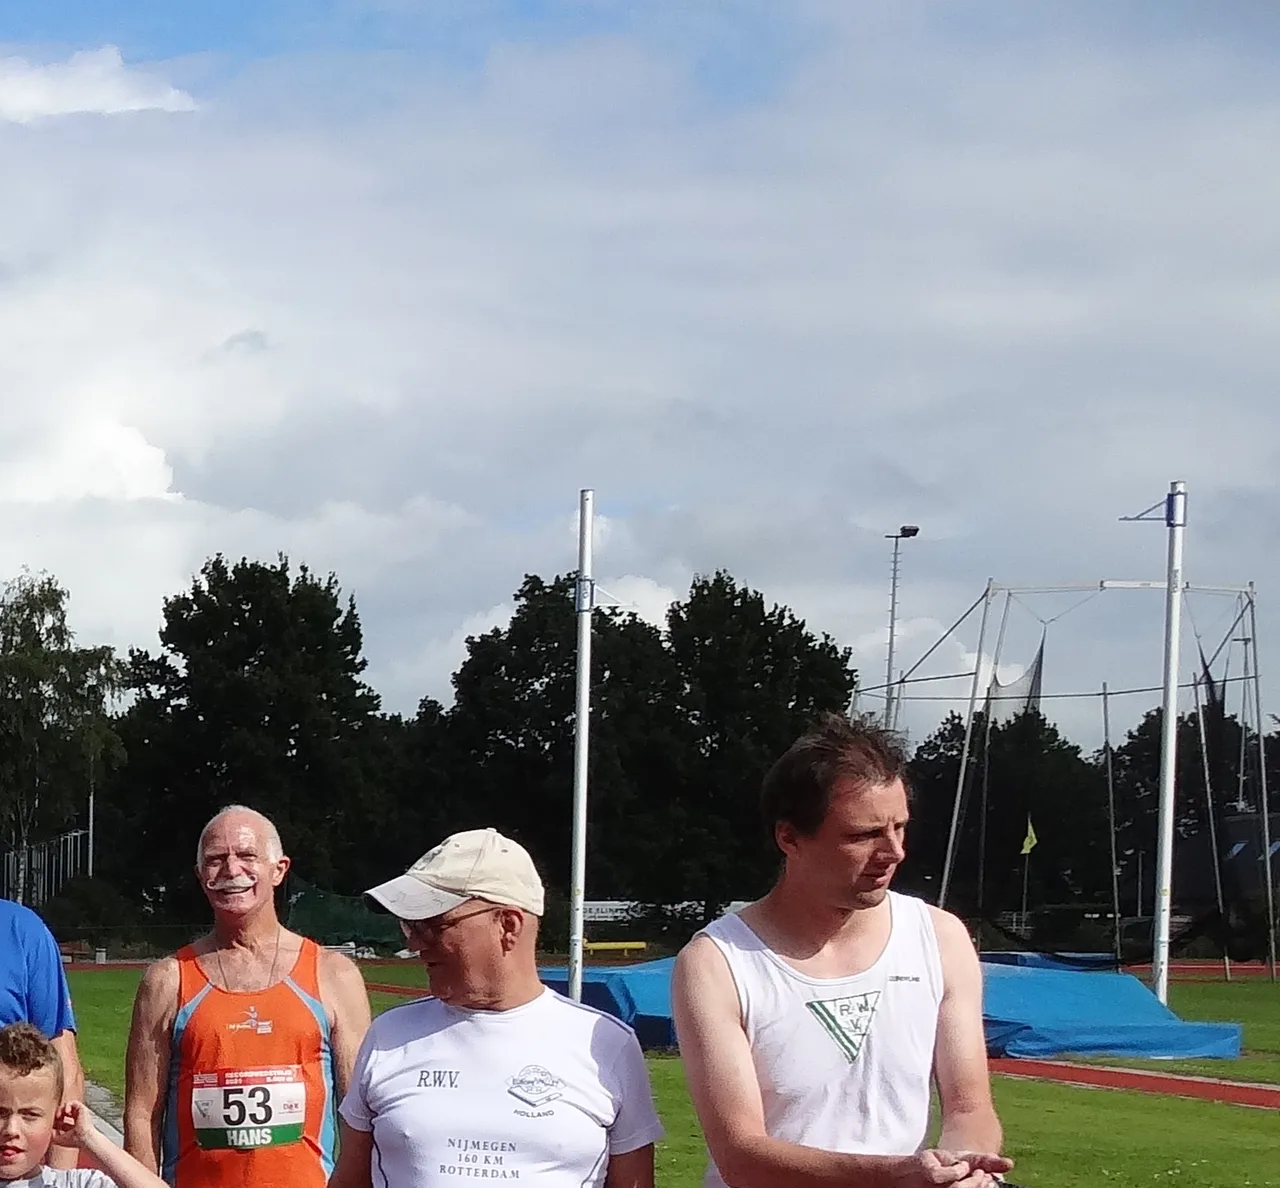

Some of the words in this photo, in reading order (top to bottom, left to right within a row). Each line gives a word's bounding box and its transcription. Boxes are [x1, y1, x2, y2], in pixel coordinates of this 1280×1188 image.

[417, 1070, 460, 1089] R.W.V.
[223, 1086, 273, 1126] 53
[513, 1109, 555, 1118] HOLLAND
[226, 1128, 273, 1146] HANS
[447, 1138, 517, 1152] NIJMEGEN
[458, 1154, 478, 1164] 160
[484, 1155, 503, 1165] KM
[440, 1164, 520, 1179] ROTTERDAM
